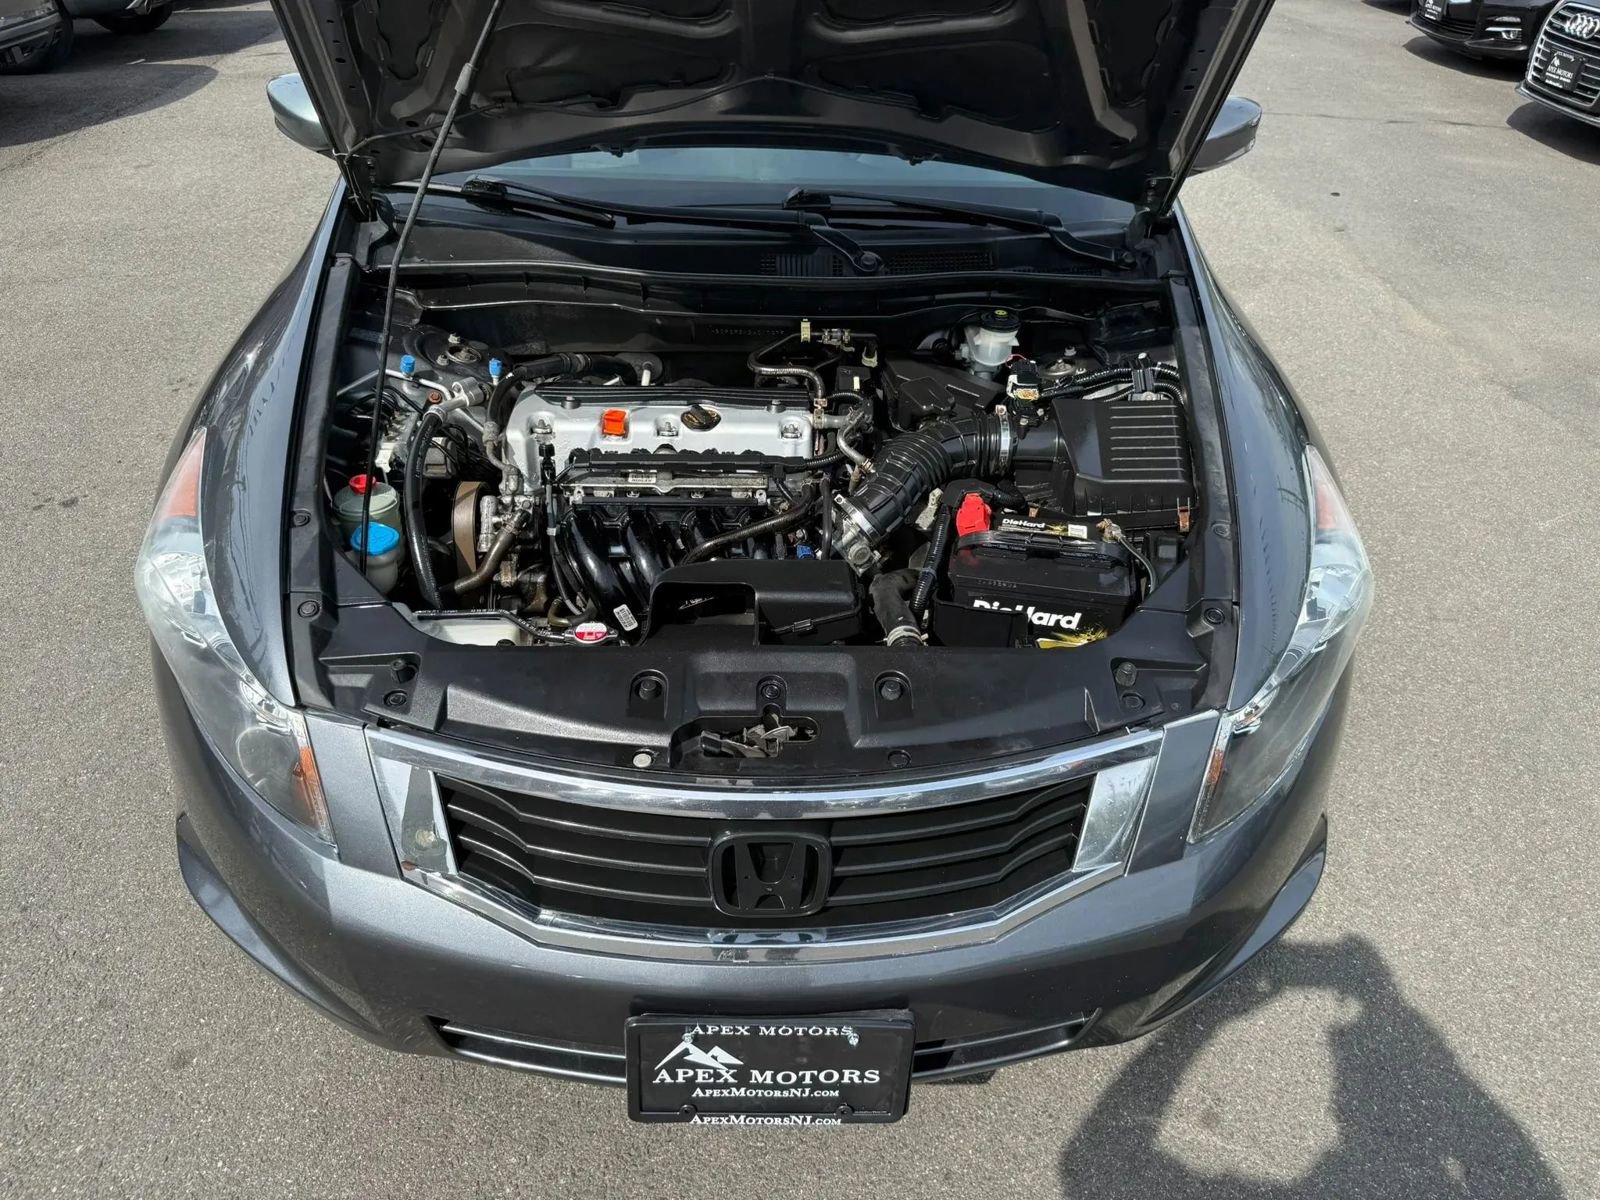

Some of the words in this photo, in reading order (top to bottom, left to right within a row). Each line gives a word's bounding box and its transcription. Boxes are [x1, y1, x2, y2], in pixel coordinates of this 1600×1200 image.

[1002, 518, 1046, 528] DieHard
[691, 1023, 750, 1035] APEX
[759, 1025, 853, 1036] MOTORS
[652, 1068, 738, 1083] APEX
[749, 1069, 880, 1084] MOTORS
